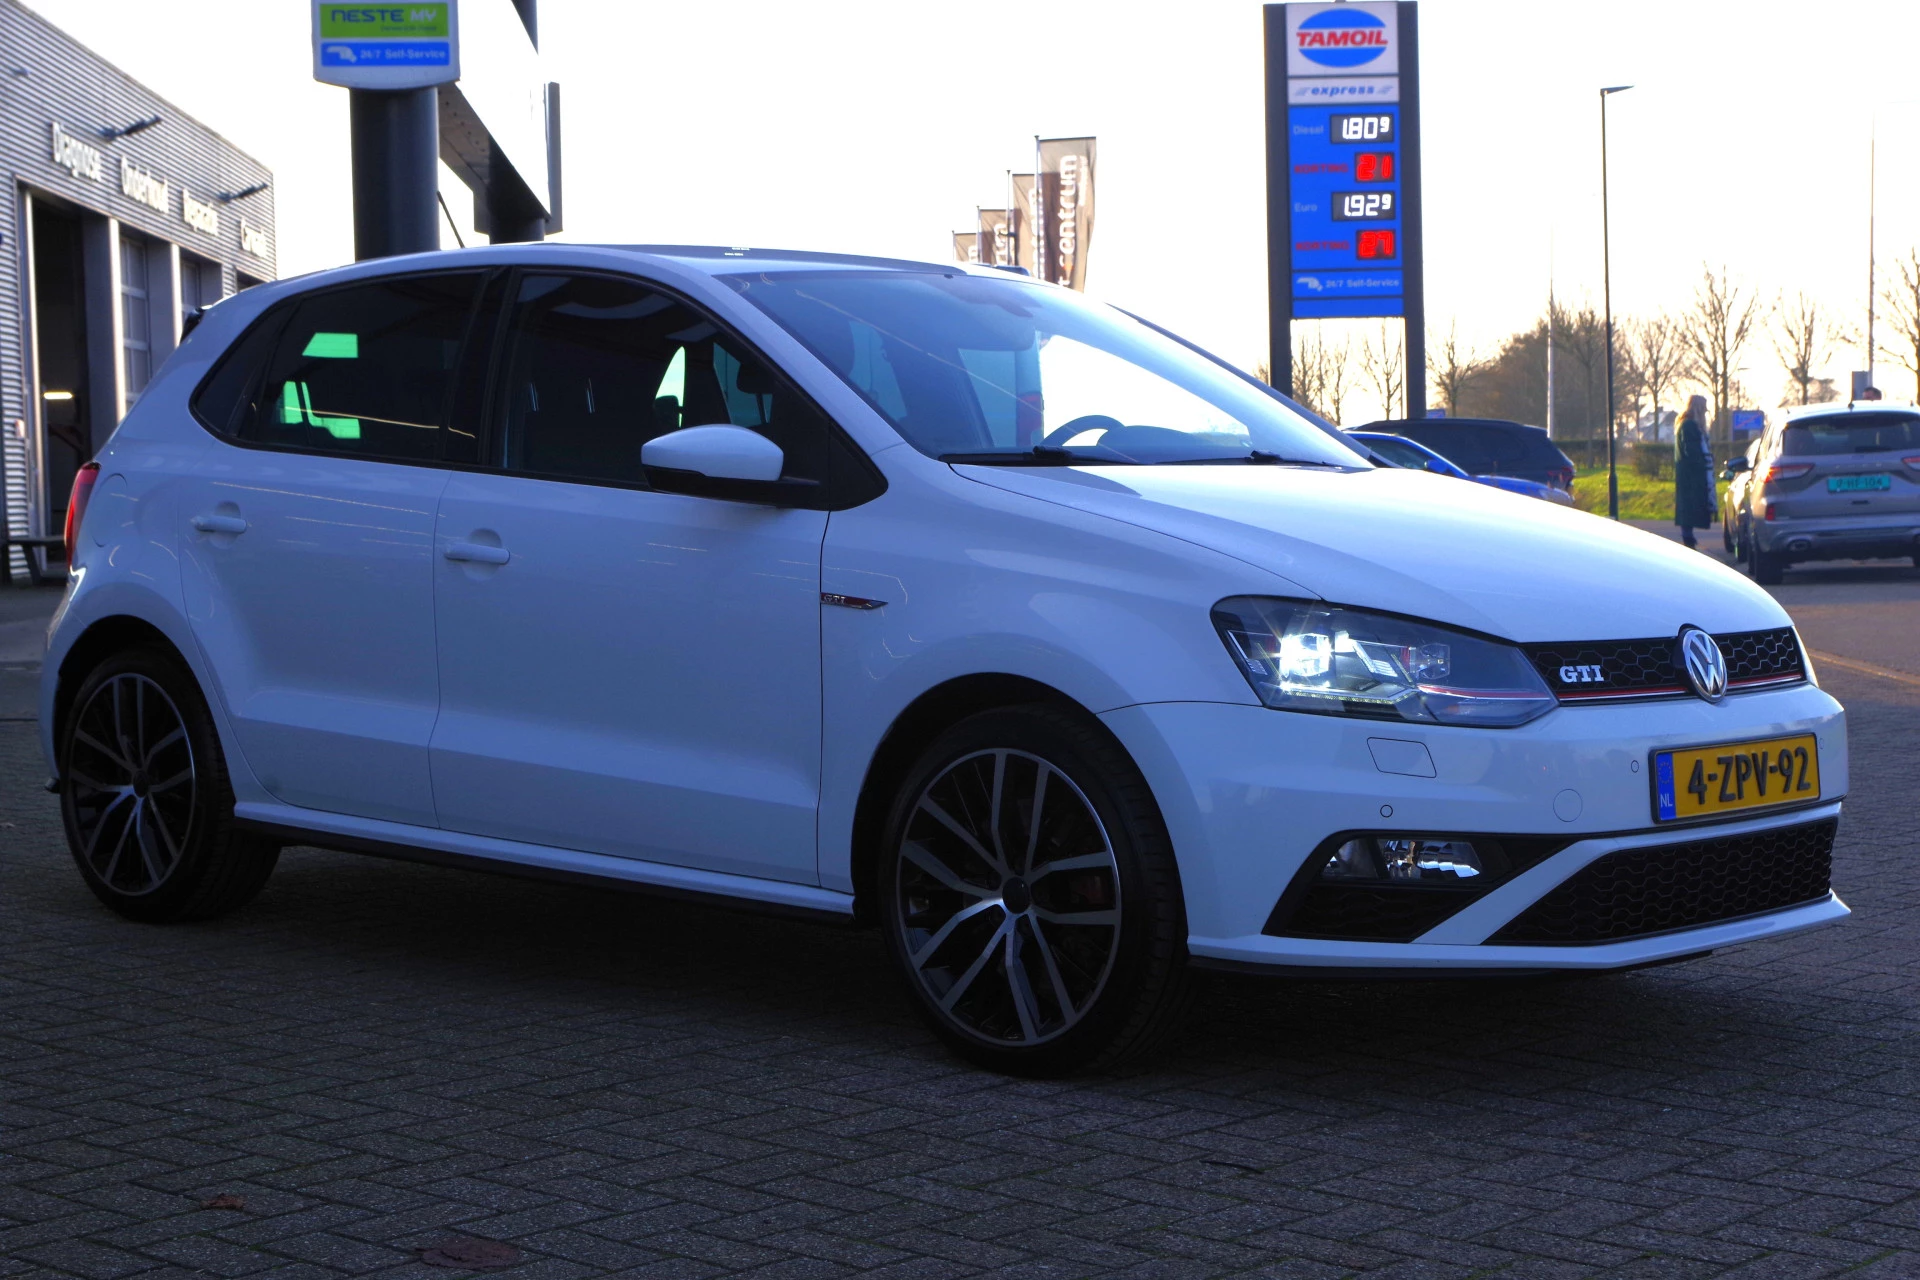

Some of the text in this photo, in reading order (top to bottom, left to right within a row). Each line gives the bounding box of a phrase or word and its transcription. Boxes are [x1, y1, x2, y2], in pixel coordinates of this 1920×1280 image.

[331, 9, 404, 22] NESTE
[1296, 30, 1388, 47] TAMOIL
[385, 48, 445, 59] Self-Service
[1311, 85, 1375, 97] express
[1293, 125, 1324, 135] Diesel
[1356, 154, 1392, 181] 21
[1294, 202, 1318, 212] Euro
[1358, 230, 1394, 258] 27
[1347, 278, 1399, 287] Self-Service
[824, 594, 846, 605] GTI
[1559, 664, 1604, 683] GTI
[1688, 746, 1811, 805] 4-ZPV-92
[1660, 792, 1674, 808] NL
